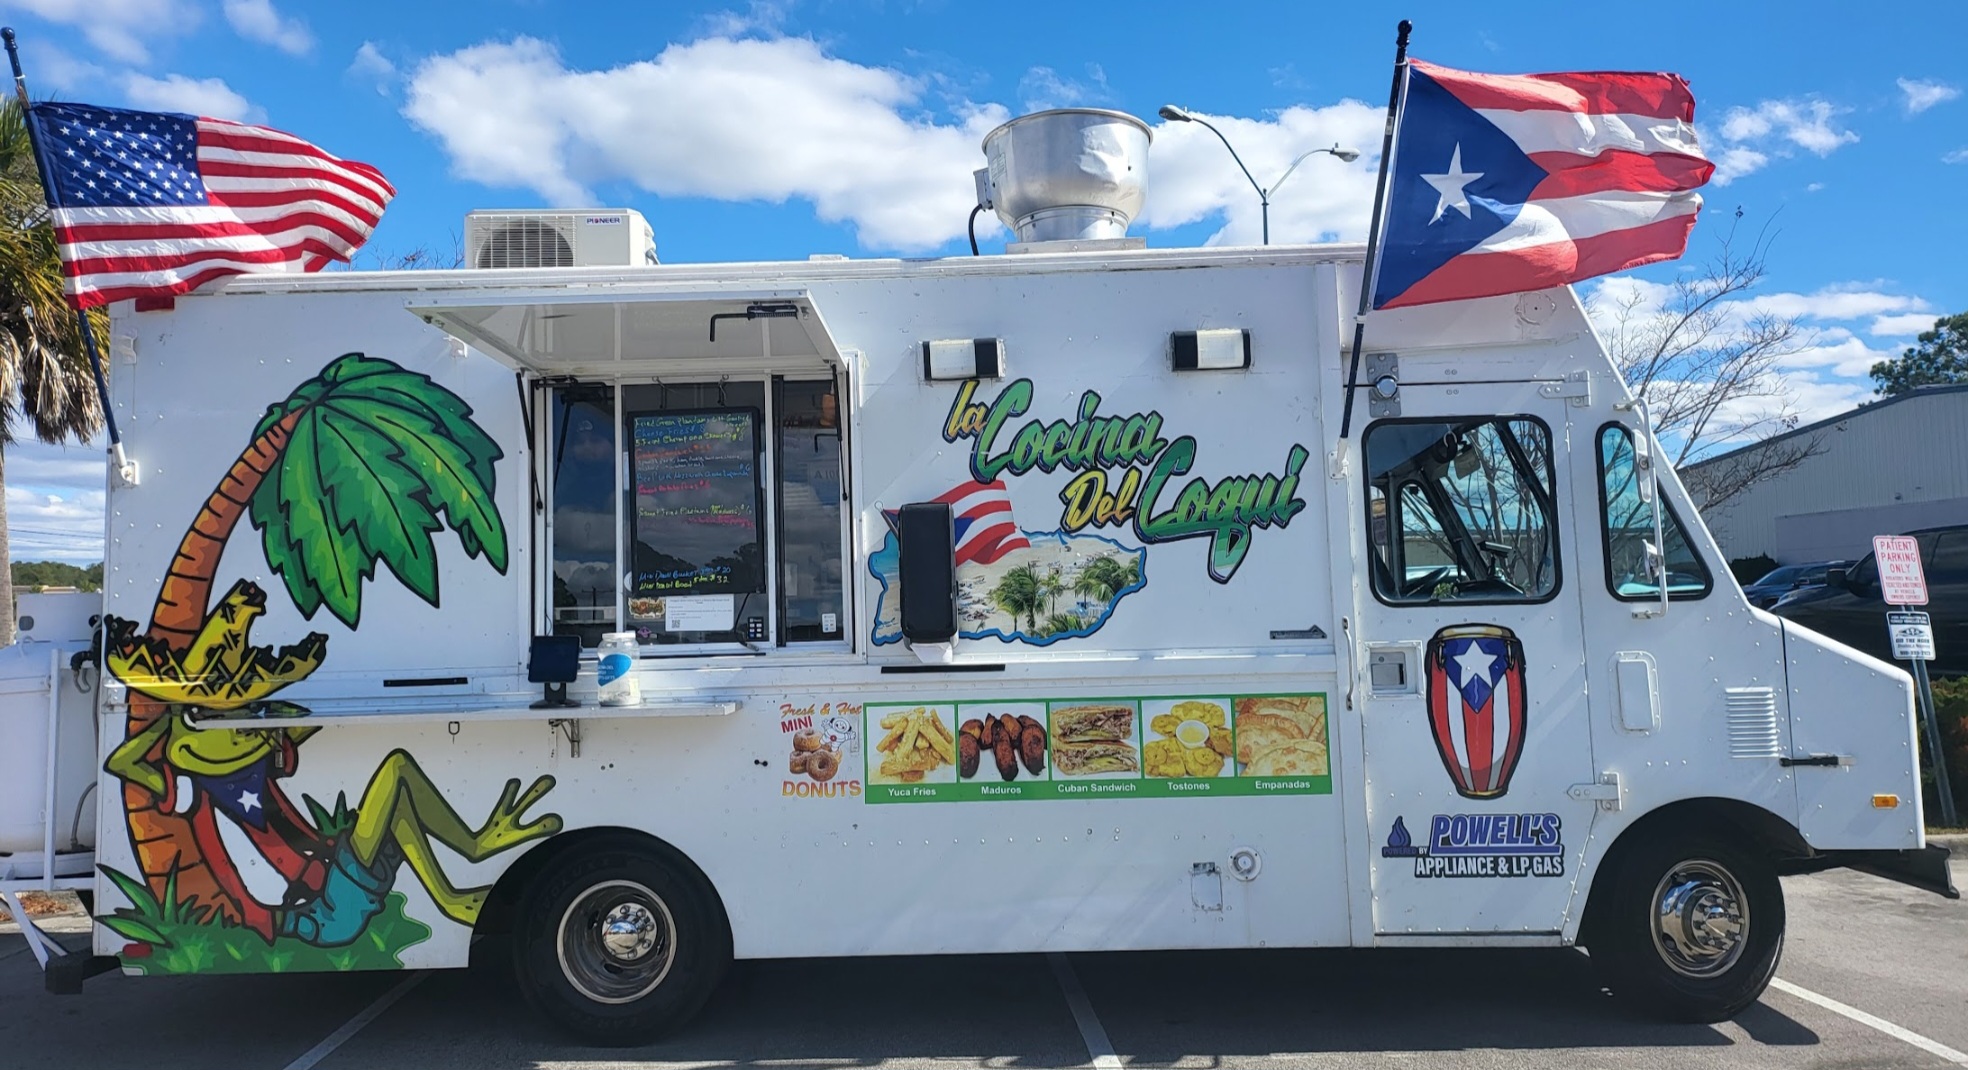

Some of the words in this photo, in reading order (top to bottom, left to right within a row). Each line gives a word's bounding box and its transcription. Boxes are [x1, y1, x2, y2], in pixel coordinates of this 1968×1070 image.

[969, 378, 1168, 484] Cocina
[1059, 466, 1134, 533] Del
[1133, 436, 1309, 584] Coqui
[1880, 541, 1912, 551] PATIENT
[1881, 552, 1916, 562] PARKING
[1889, 563, 1911, 574] ONLY
[780, 703, 816, 718] Fresh
[820, 703, 831, 716] &
[836, 703, 862, 716] Hot
[781, 716, 813, 733] MINI
[782, 780, 862, 798] DONUTS
[981, 786, 1022, 795] Maduros
[1057, 784, 1088, 793] Cuban
[1090, 783, 1136, 793] Sandwich
[1167, 782, 1210, 791] Tostones
[1255, 780, 1311, 791] Empanadas
[888, 788, 911, 797] Yuca
[913, 787, 936, 796] Fries
[1430, 813, 1561, 850] POWELL'S
[1383, 847, 1417, 856] POWERED
[1418, 847, 1429, 855] BY
[1416, 857, 1495, 876] APPLIANCE
[1497, 857, 1510, 875] &
[1512, 857, 1532, 875] LP
[1532, 857, 1563, 875] GAS
